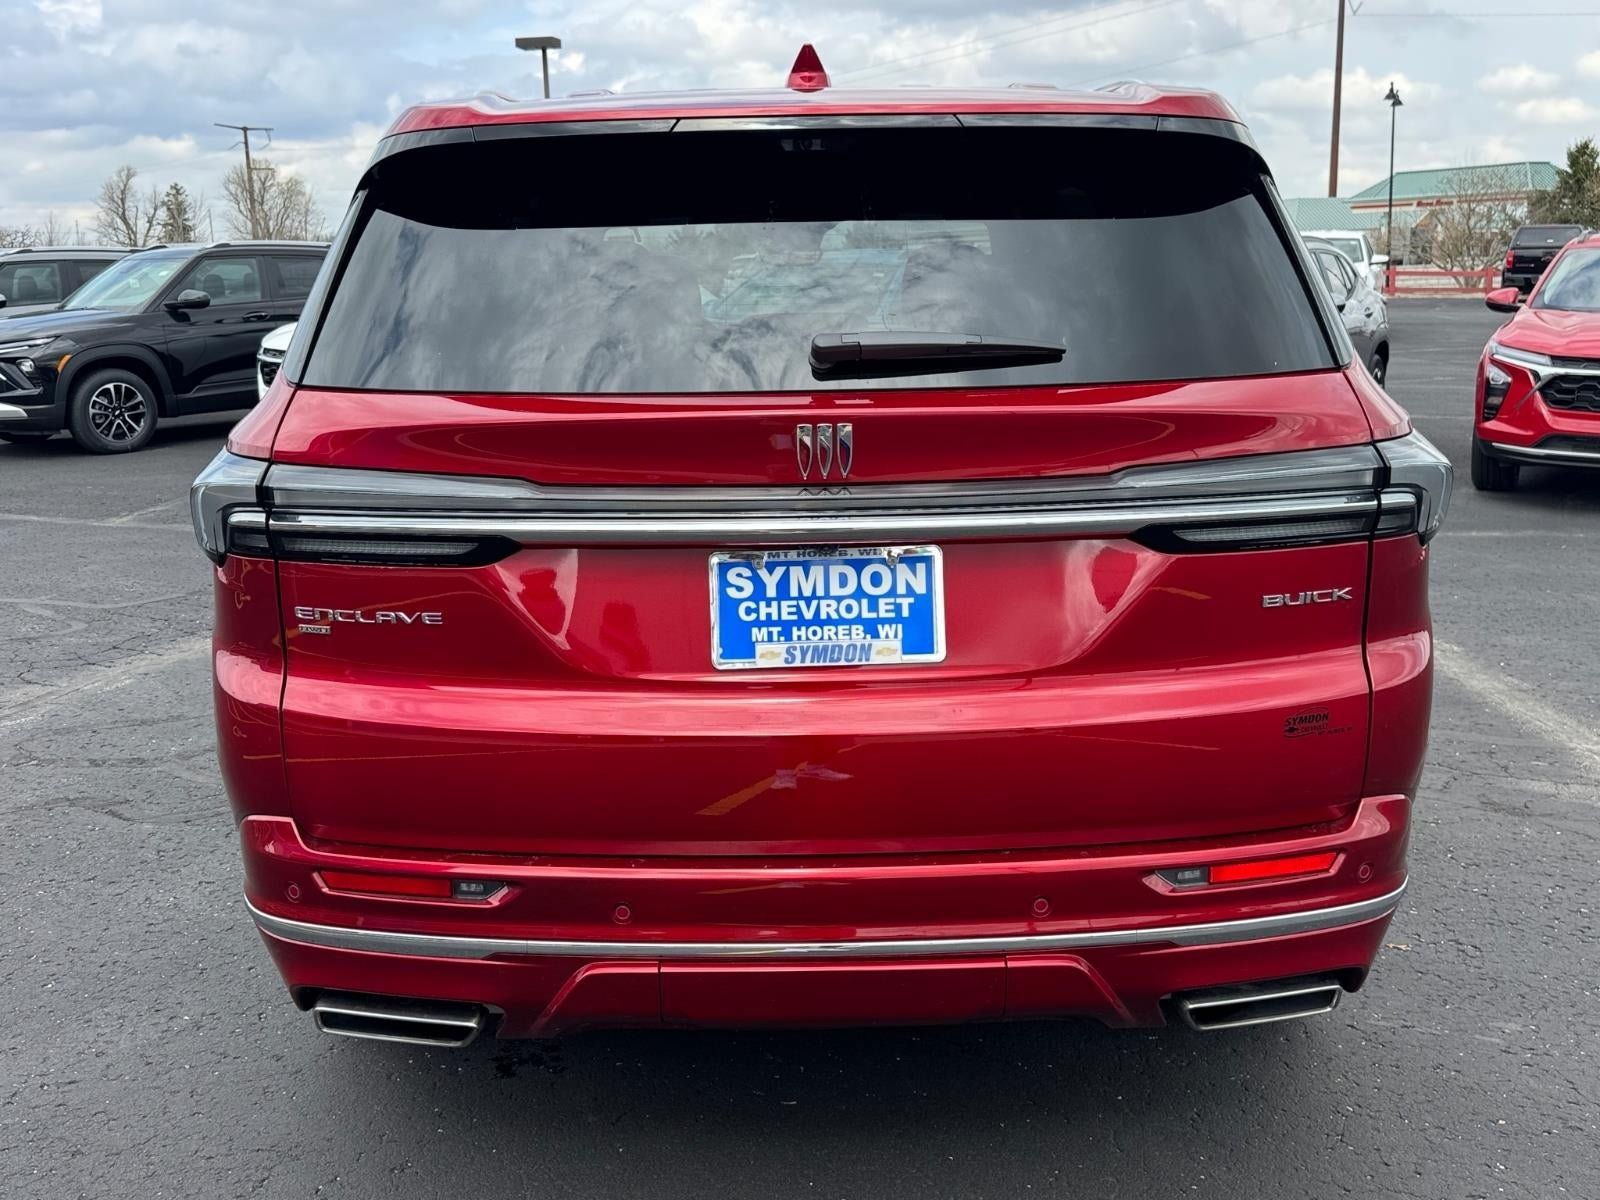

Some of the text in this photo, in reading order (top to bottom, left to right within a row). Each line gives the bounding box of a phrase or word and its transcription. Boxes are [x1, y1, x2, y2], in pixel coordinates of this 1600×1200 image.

[725, 563, 927, 599] SYMDON
[1263, 587, 1352, 608] BUICK
[294, 606, 443, 625] ENCLAVE
[738, 597, 914, 622] CHEVROLET
[751, 623, 903, 643] MT. HOREB, WI
[784, 642, 873, 665] SYMDON
[1285, 711, 1329, 727] SYMDON
